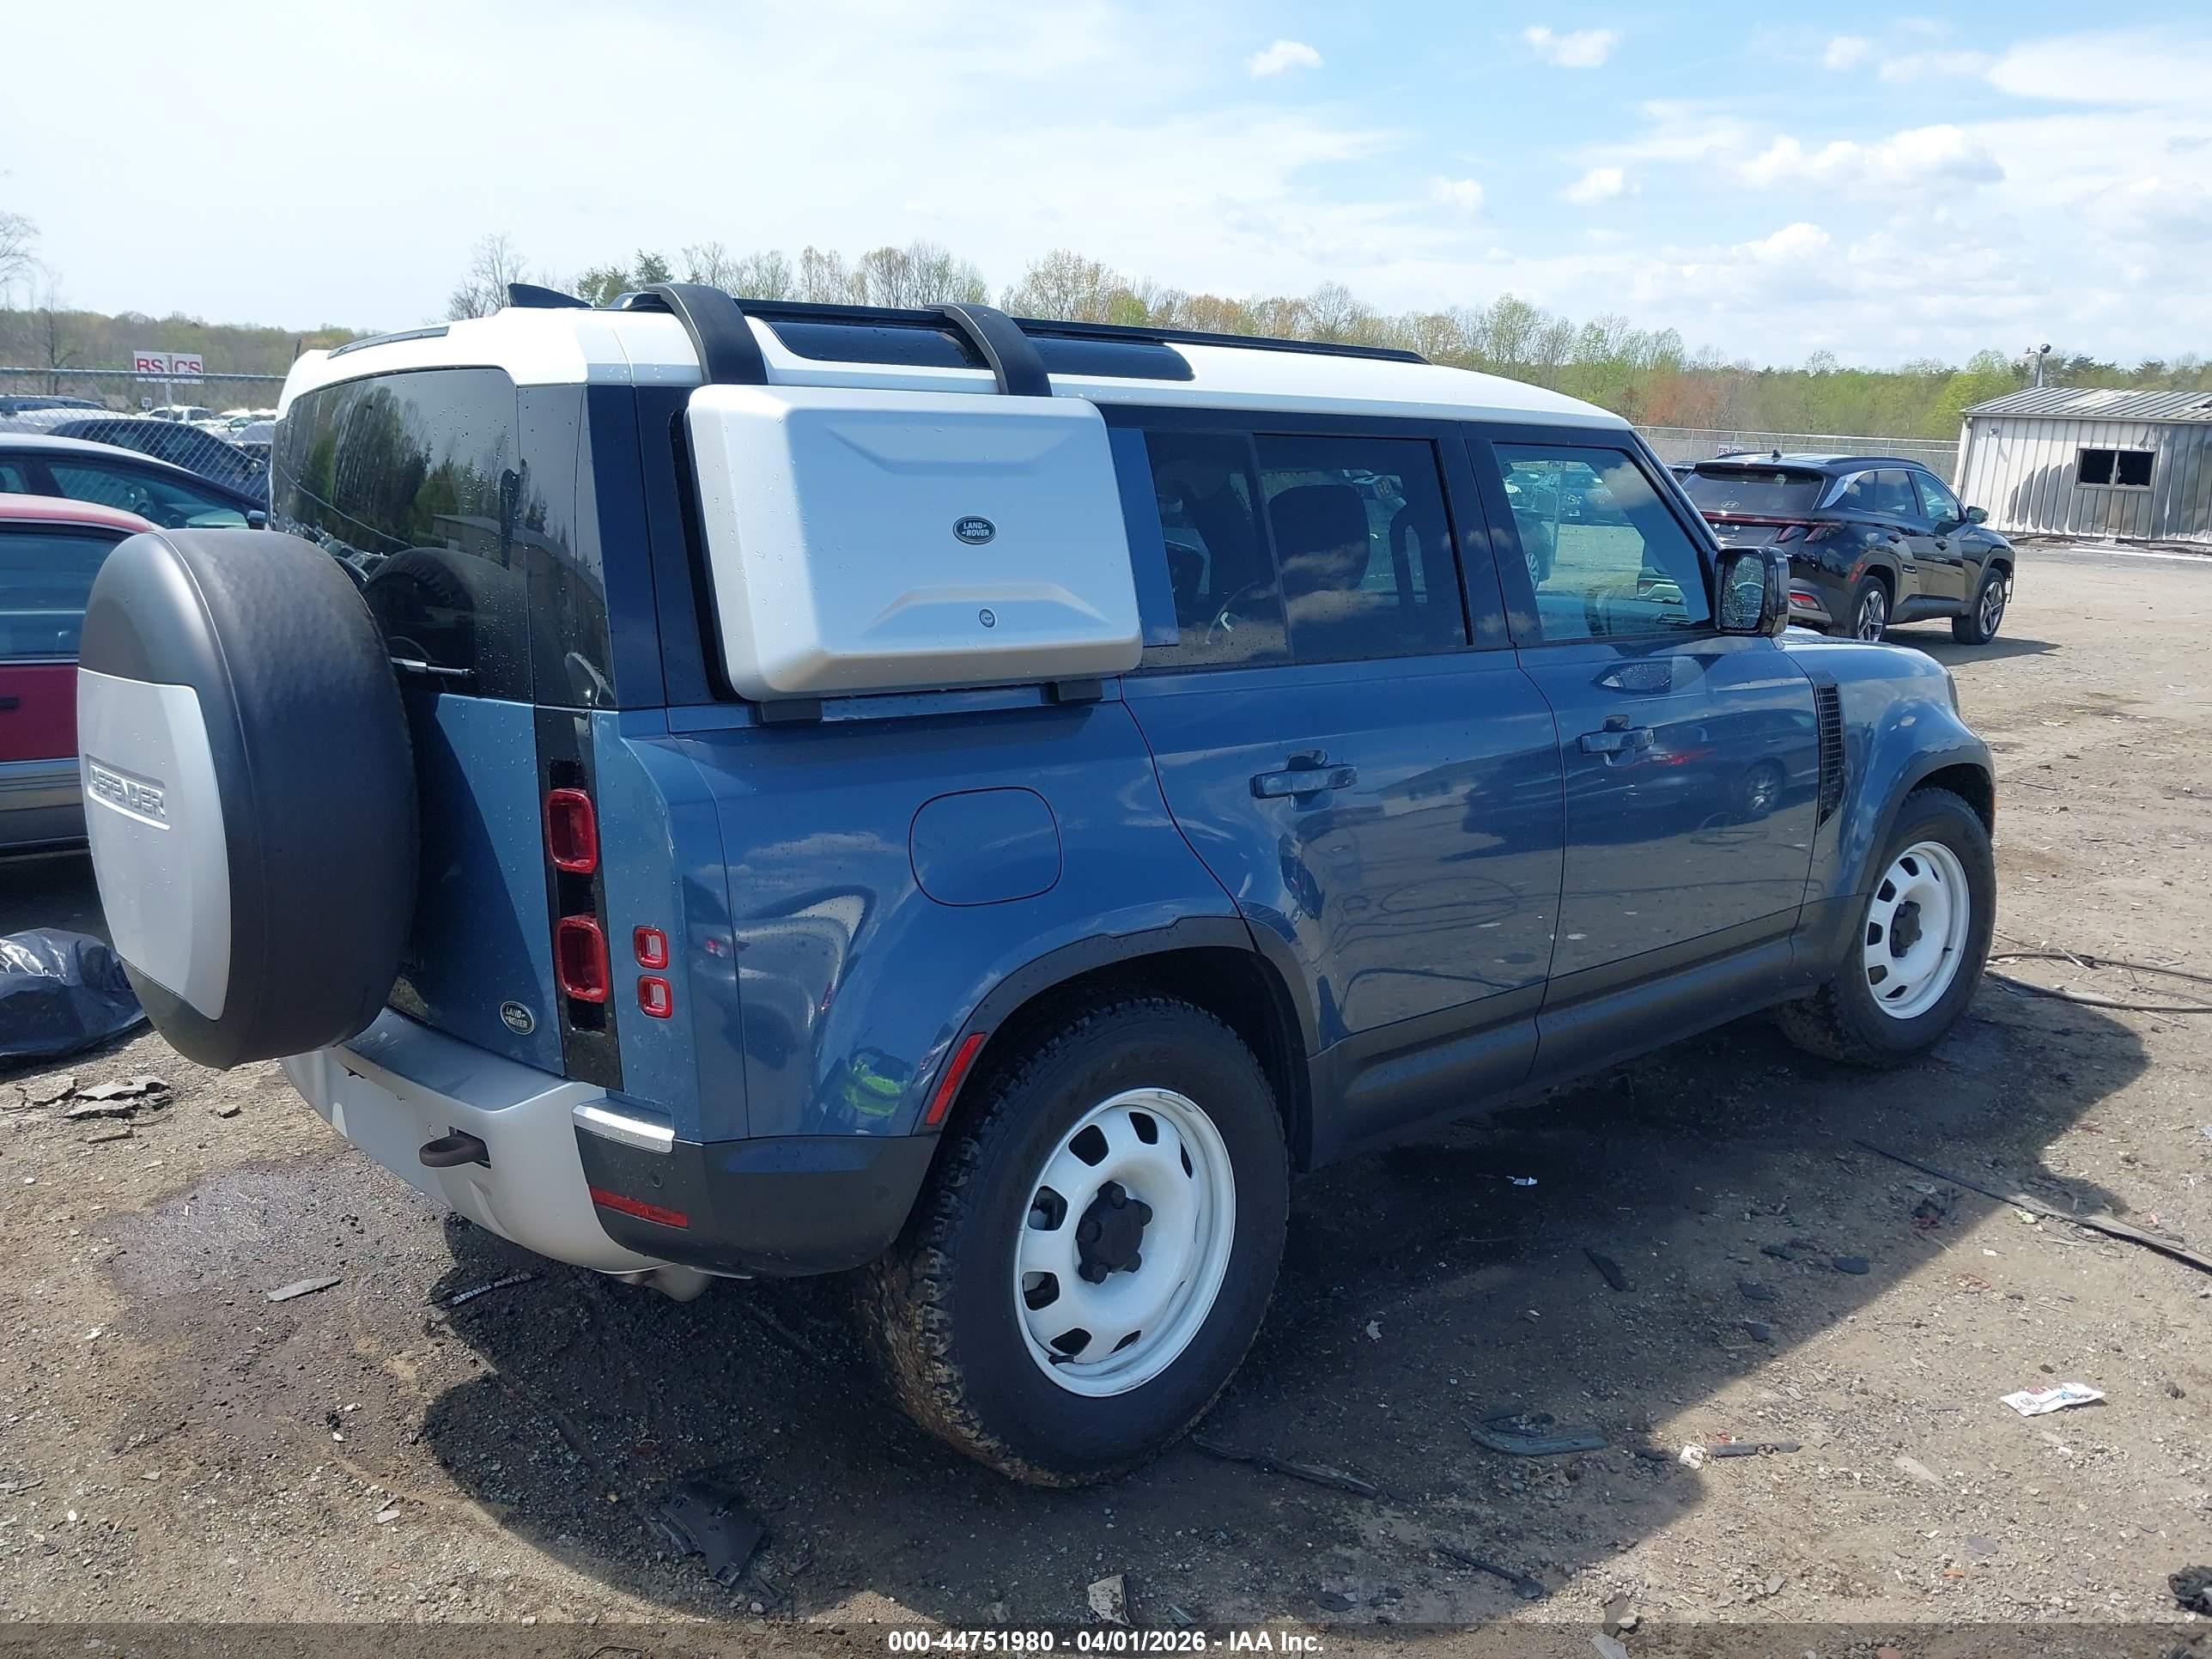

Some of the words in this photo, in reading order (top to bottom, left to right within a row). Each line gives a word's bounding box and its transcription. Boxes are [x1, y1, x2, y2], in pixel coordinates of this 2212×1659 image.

[963, 521, 983, 530] LAND
[88, 762, 167, 819] DEFENDER
[506, 1006, 522, 1018] LAND
[508, 1016, 528, 1028] ROVER
